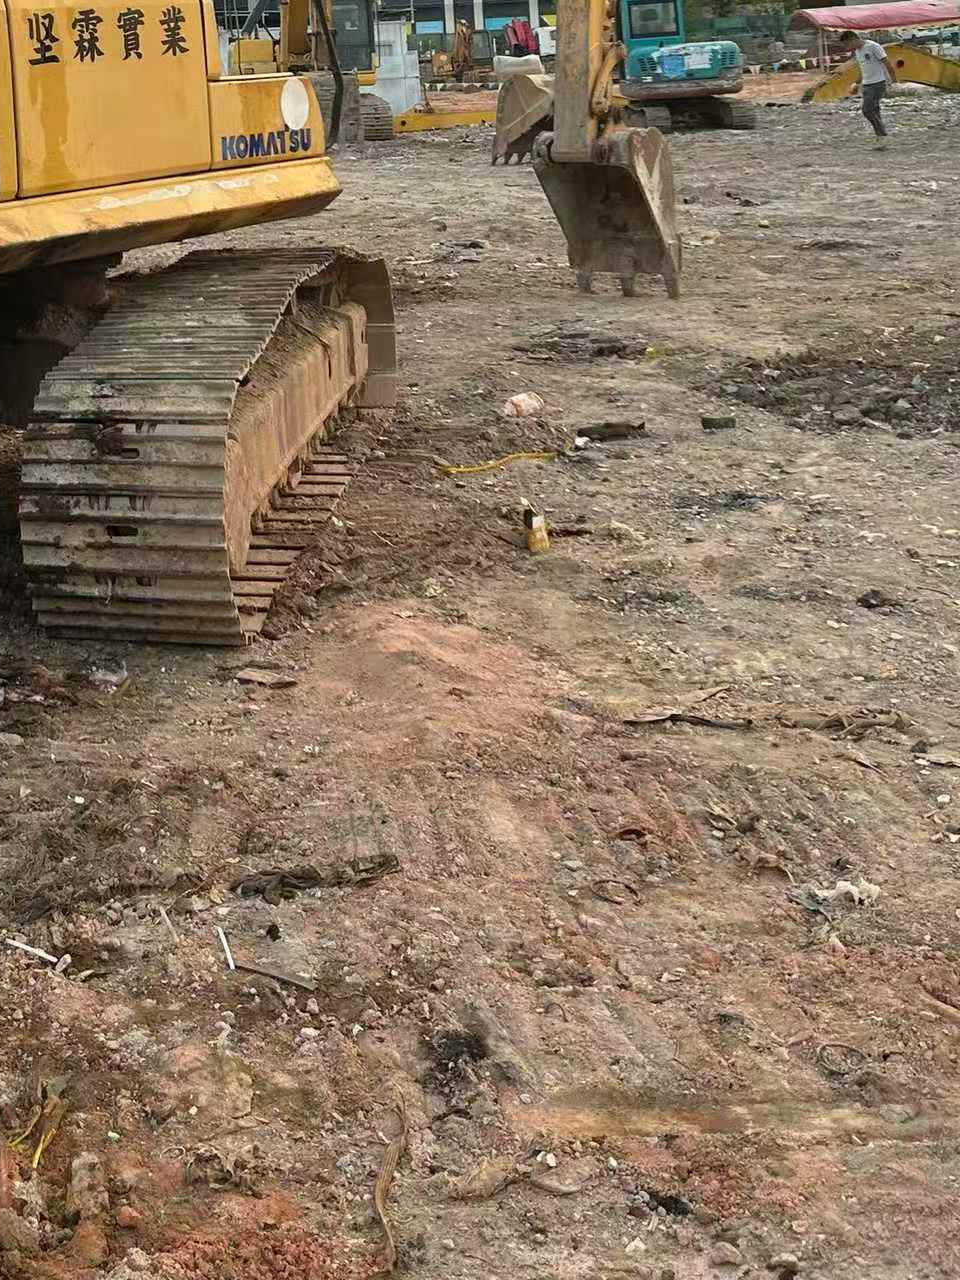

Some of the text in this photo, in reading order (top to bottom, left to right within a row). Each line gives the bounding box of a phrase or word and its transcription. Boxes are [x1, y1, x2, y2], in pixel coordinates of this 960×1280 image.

[27, 6, 189, 66] 坚霖實業
[221, 127, 311, 160] KOMATSU
